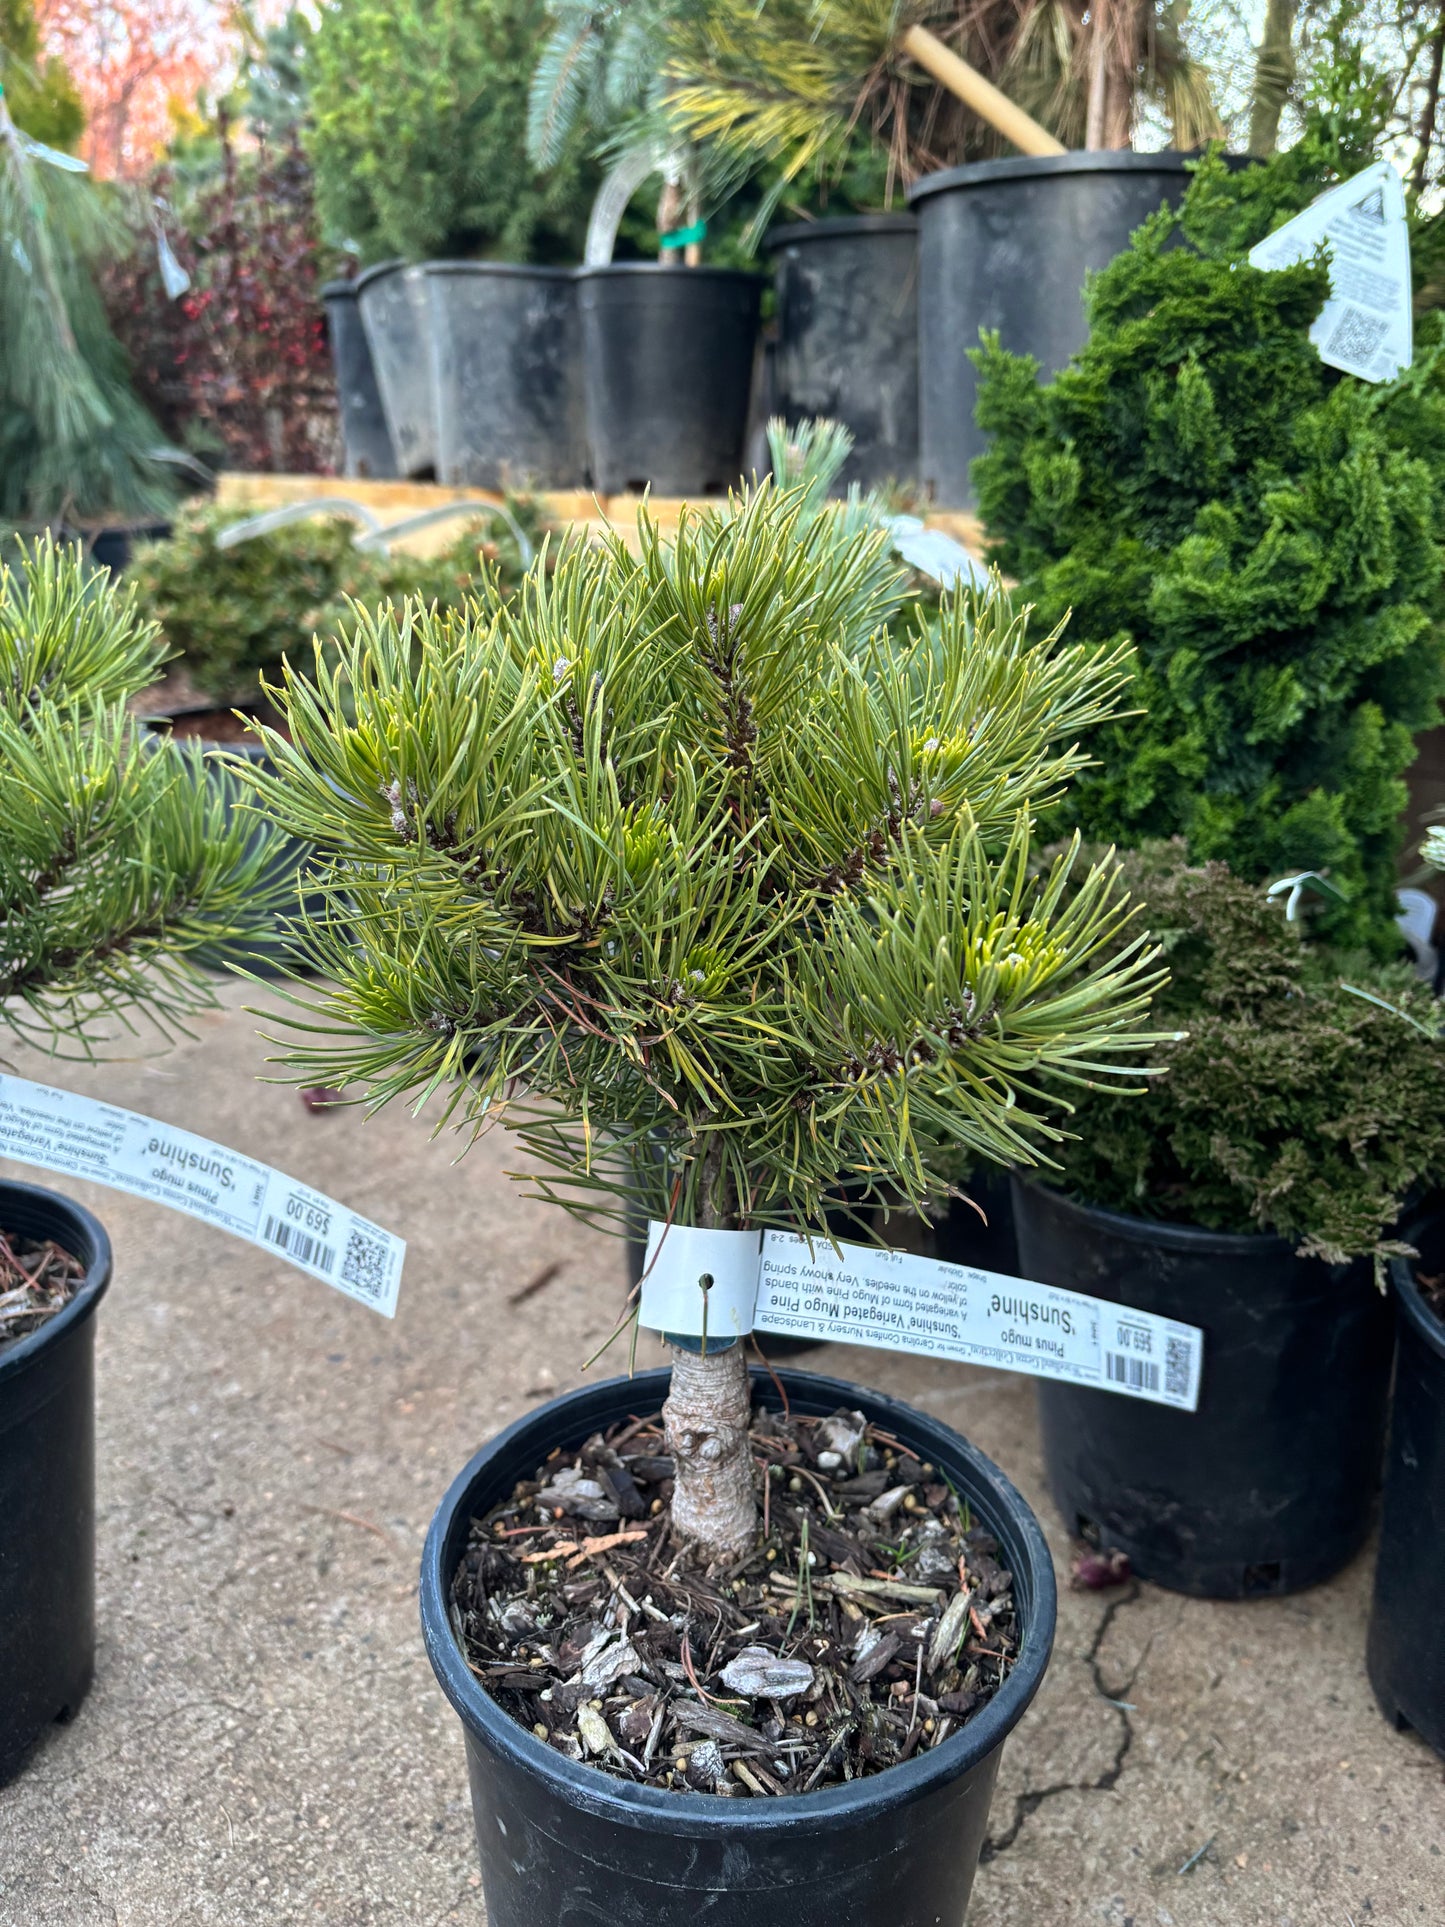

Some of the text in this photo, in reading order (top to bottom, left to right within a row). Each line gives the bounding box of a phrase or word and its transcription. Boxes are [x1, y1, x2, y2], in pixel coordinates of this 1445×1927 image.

[142, 1138, 236, 1191] 'Sunshine'
[152, 1169, 219, 1205] Pinus mugo
[286, 1199, 330, 1236] $69.00
[816, 1240, 832, 1250] SDA
[875, 1252, 889, 1263] Sun
[891, 1254, 902, 1264] Full
[763, 1260, 797, 1276] spring
[800, 1266, 834, 1281] showy
[836, 1272, 859, 1287] Very
[903, 1285, 917, 1297] the
[919, 1289, 929, 1299] on
[931, 1291, 957, 1305] yellow
[765, 1277, 967, 1321] A variegated form of Mugo Pine with bands
[959, 1297, 967, 1307] of
[761, 1314, 815, 1331] Landscape
[770, 1295, 960, 1339] 'Sunshine' Variegated Mugo Pine
[987, 1294, 1076, 1336] 'Sunshine'
[818, 1322, 825, 1332] &
[828, 1321, 862, 1337] Nursery
[866, 1330, 899, 1344] Conifers
[902, 1336, 934, 1350] Carolina
[1000, 1329, 1064, 1358] Pinus mugo
[1117, 1327, 1152, 1354] $69.00
